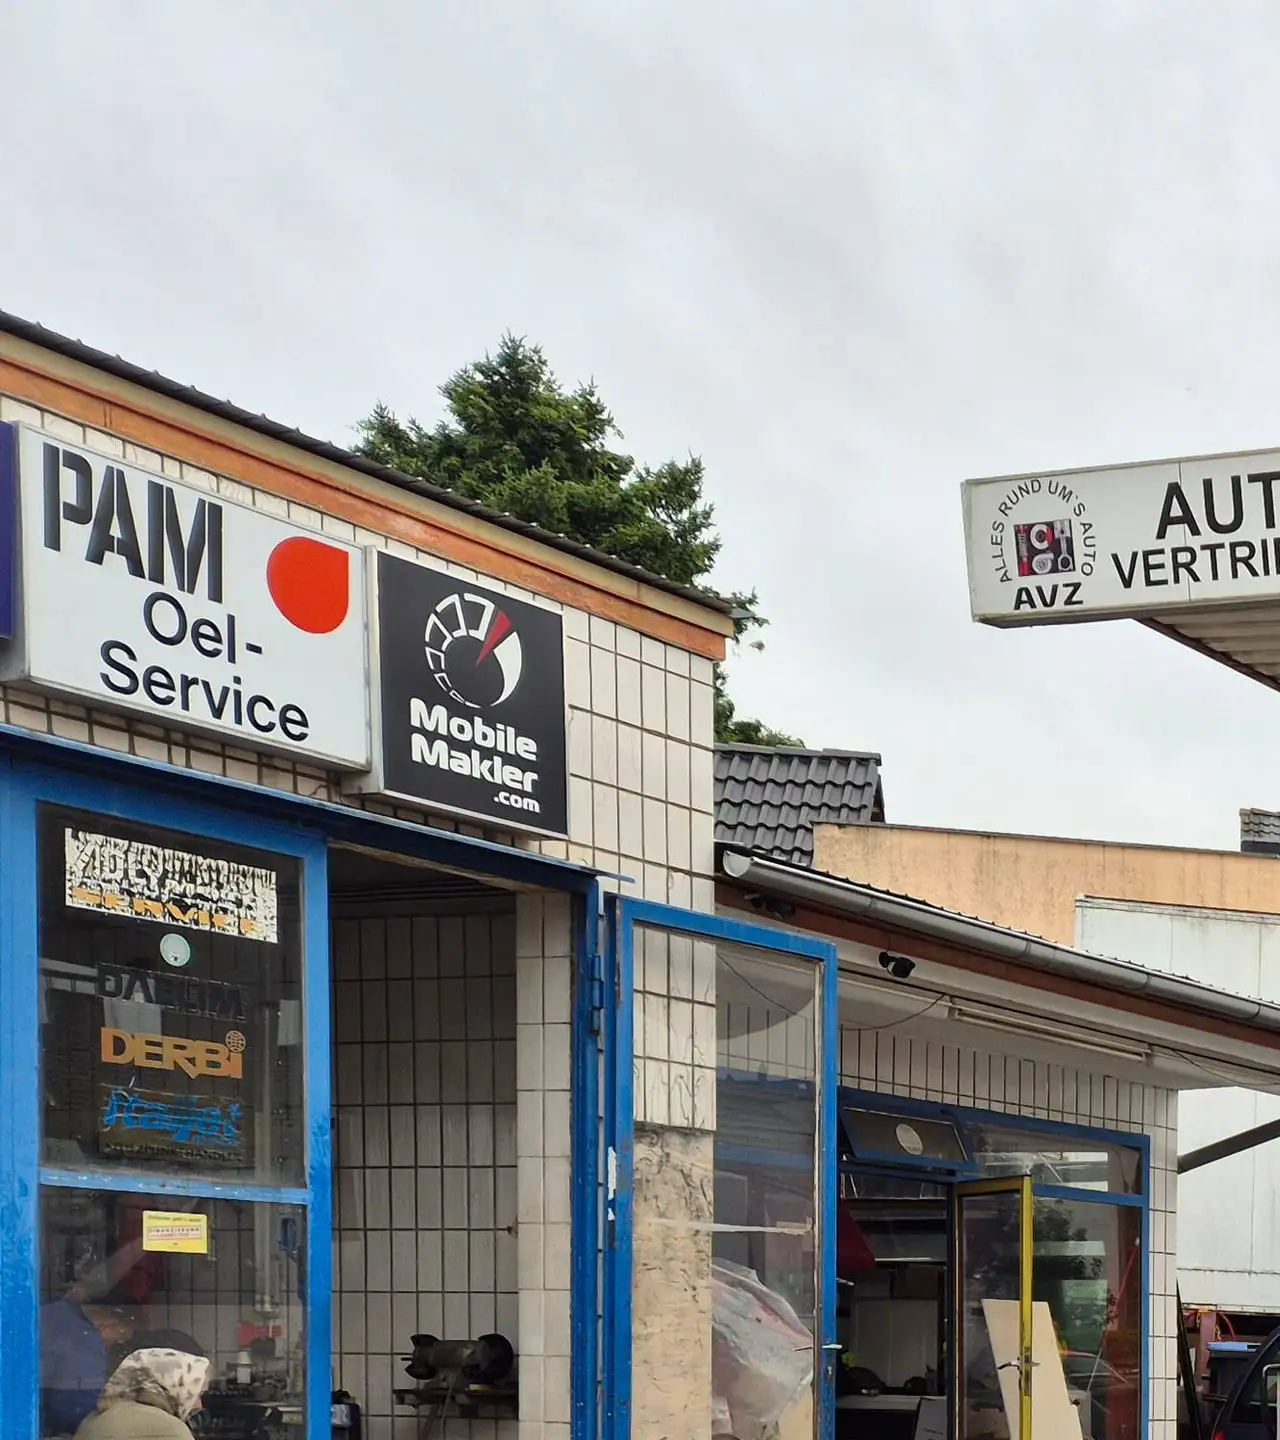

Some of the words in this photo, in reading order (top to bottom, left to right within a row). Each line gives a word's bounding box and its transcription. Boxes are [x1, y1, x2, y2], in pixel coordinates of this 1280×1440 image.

[42, 441, 223, 604] PAM
[998, 479, 1042, 517] RUND
[990, 520, 1013, 583] ALLES
[1080, 521, 1096, 577] AUTO
[1013, 581, 1084, 611] AVZ
[142, 591, 263, 664] Oel-
[99, 639, 310, 742] Service
[410, 697, 538, 761] Mobile
[411, 732, 539, 793] Makler
[493, 791, 541, 813] .com
